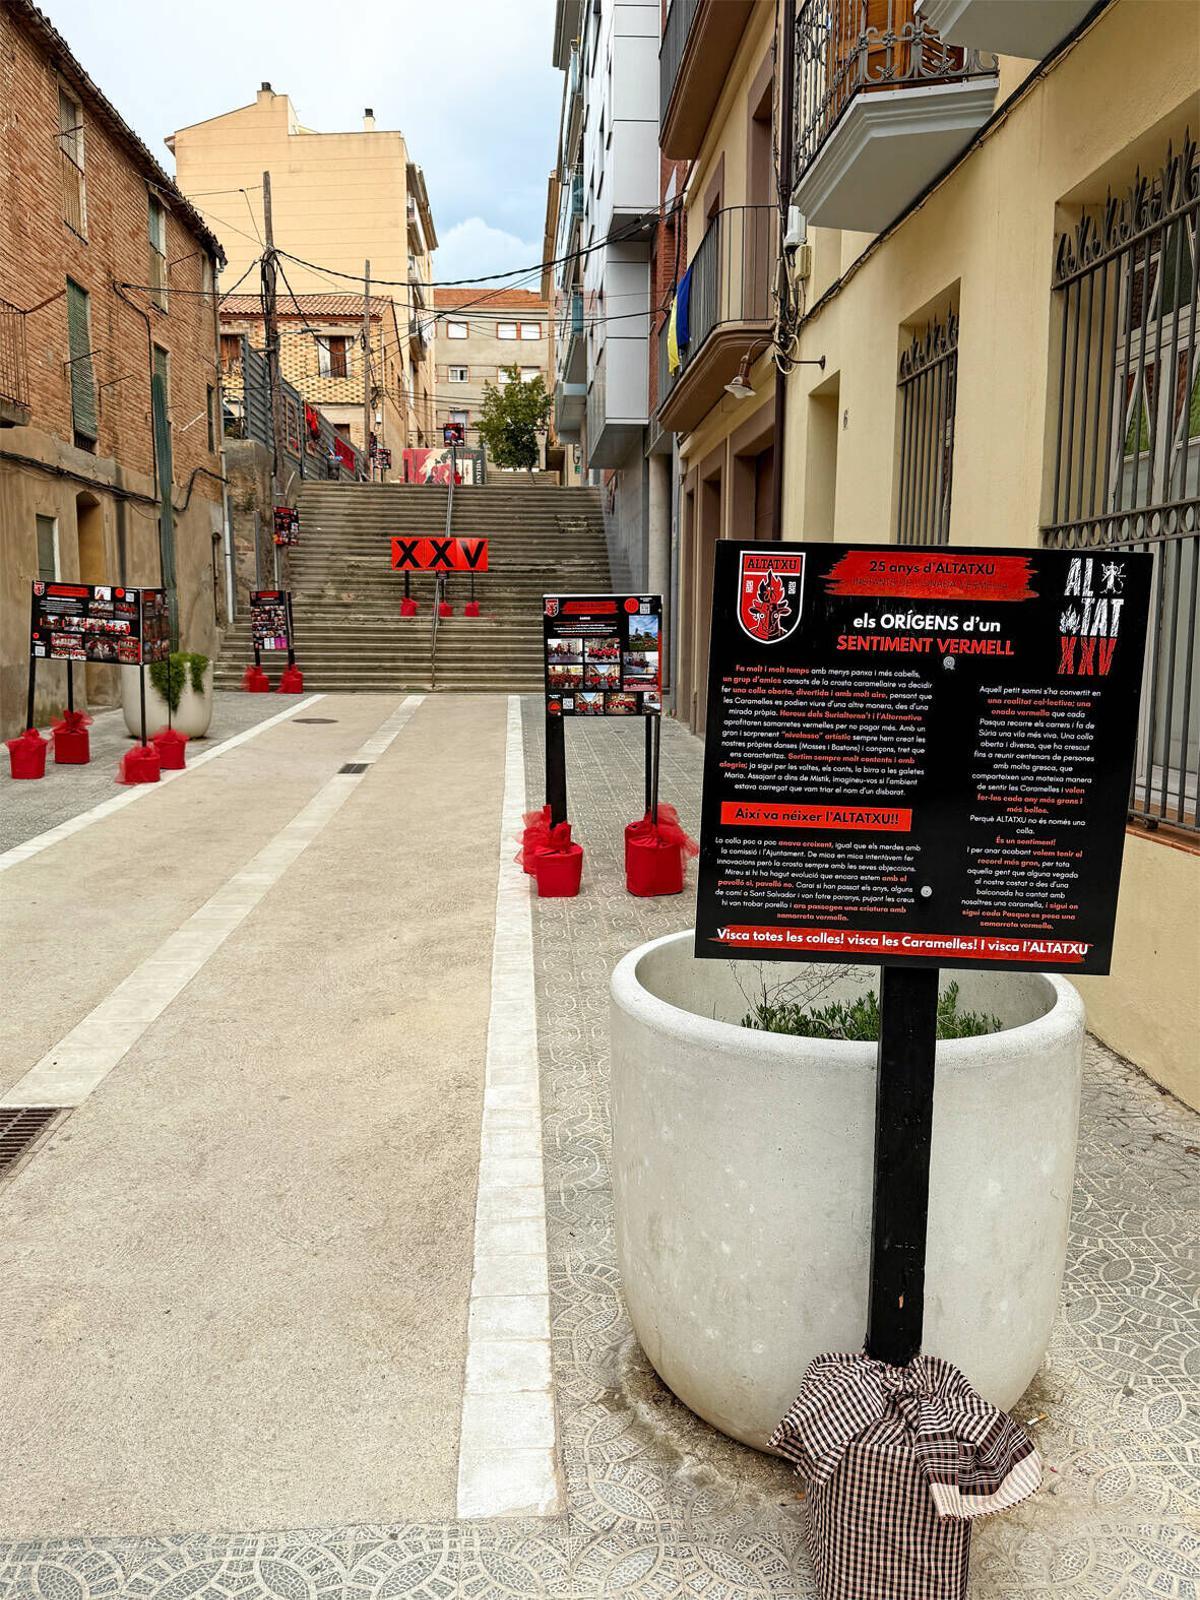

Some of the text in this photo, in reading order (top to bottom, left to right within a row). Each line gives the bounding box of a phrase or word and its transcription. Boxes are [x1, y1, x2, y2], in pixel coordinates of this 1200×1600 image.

[748, 559, 797, 569] ALTATXU
[869, 561, 995, 575] 25 anys d'ALTATXU
[1065, 558, 1094, 597] AL
[853, 611, 1001, 632] els ORÍGENS d'un
[1080, 598, 1124, 637] TAT
[836, 636, 1015, 656] SENTIMENT VERMELL
[1057, 637, 1118, 676] XXV
[827, 668, 849, 676] menys
[850, 669, 872, 677] panxa
[782, 676, 809, 684] cansats
[853, 679, 896, 687] caramellaire
[907, 681, 932, 689] decidir
[979, 685, 1002, 694] Aquell
[1003, 686, 1020, 695] petit
[1021, 686, 1042, 694] somni
[1059, 688, 1090, 696] convertit
[889, 691, 917, 701] pensant
[734, 696, 773, 704] Caramelles
[783, 698, 808, 707] podien
[723, 717, 879, 732] aprofitaren samarretes vermelles pagar
[979, 718, 1005, 727] Pasqua
[743, 729, 779, 739] sorprenent
[1076, 732, 1094, 740] colla
[721, 739, 745, 747] nostres
[746, 740, 772, 749] pròpies
[773, 741, 797, 749] danses
[980, 739, 1004, 747] oberta
[1063, 742, 1090, 750] crescut
[1015, 752, 1051, 760] centenars
[1062, 755, 1094, 763] persones
[757, 762, 773, 770] sigui
[898, 767, 924, 776] galetes
[1010, 762, 1030, 770] molta
[886, 777, 917, 785] l'ambient
[971, 771, 1019, 782] comparteixen
[1035, 774, 1064, 782] mateixa
[758, 783, 787, 792] carregat
[1019, 784, 1059, 792] Caramelles
[735, 808, 899, 825] Així va néixer l'ALTATXU!!
[996, 815, 1026, 823] ALTATXU
[1015, 826, 1035, 834] colla.
[835, 841, 852, 850] igual
[728, 847, 757, 855] comissió
[762, 848, 805, 858] l'Ajuntament.
[1001, 847, 1031, 855] acabant
[756, 859, 772, 867] però
[804, 862, 829, 870] sempre
[790, 870, 818, 878] evolució
[966, 867, 1078, 879] aquella gent alguna vegada
[766, 890, 796, 898] Salvador
[890, 885, 913, 894] alguns
[976, 888, 1013, 896] balconada
[742, 899, 763, 907] trobar
[717, 928, 1088, 955] Visca totes les colles! visca les Caramelles! I visca l'ALTATXU
